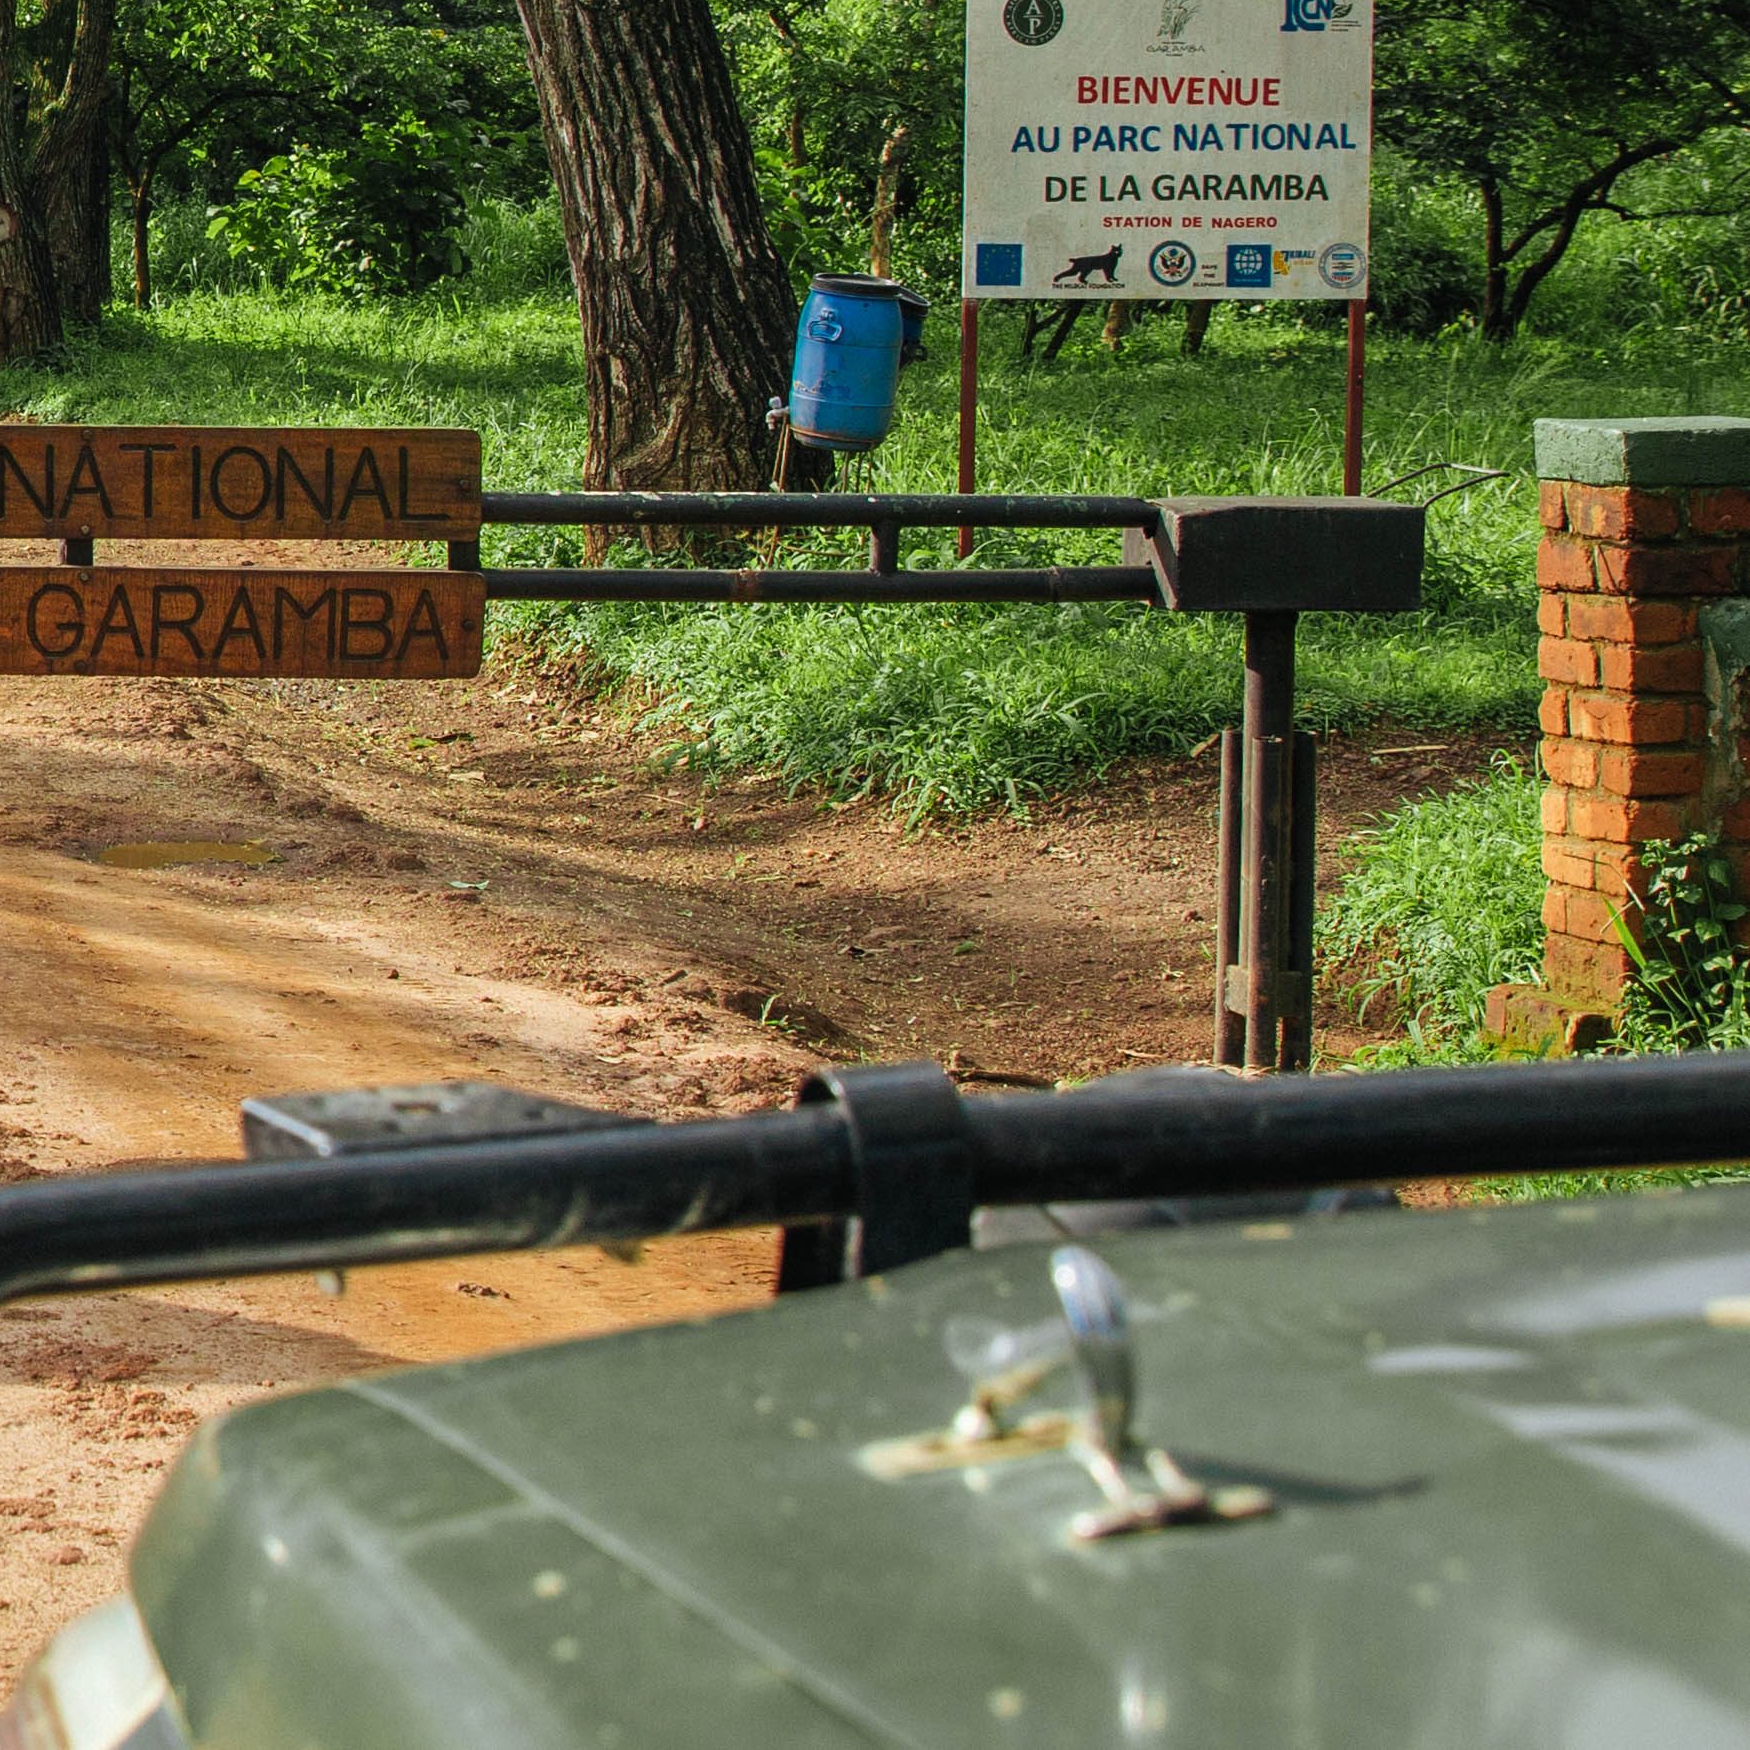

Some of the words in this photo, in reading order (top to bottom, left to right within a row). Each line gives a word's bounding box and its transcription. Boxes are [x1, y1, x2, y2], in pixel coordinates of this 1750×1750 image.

[1146, 44, 1205, 53] GARAMBA
[1077, 76, 1281, 106] BIENVENUE
[1011, 126, 1060, 153] AU
[1072, 125, 1161, 152] PARC
[1173, 123, 1357, 151] NATIONAL
[1045, 176, 1087, 202] DE
[1099, 175, 1141, 202] LA
[1151, 174, 1329, 202] GARAMBA
[1103, 217, 1172, 228] STATION
[1182, 217, 1202, 228] DE
[1212, 217, 1277, 229] NAGERO
[26, 583, 449, 662] GARAMBA
